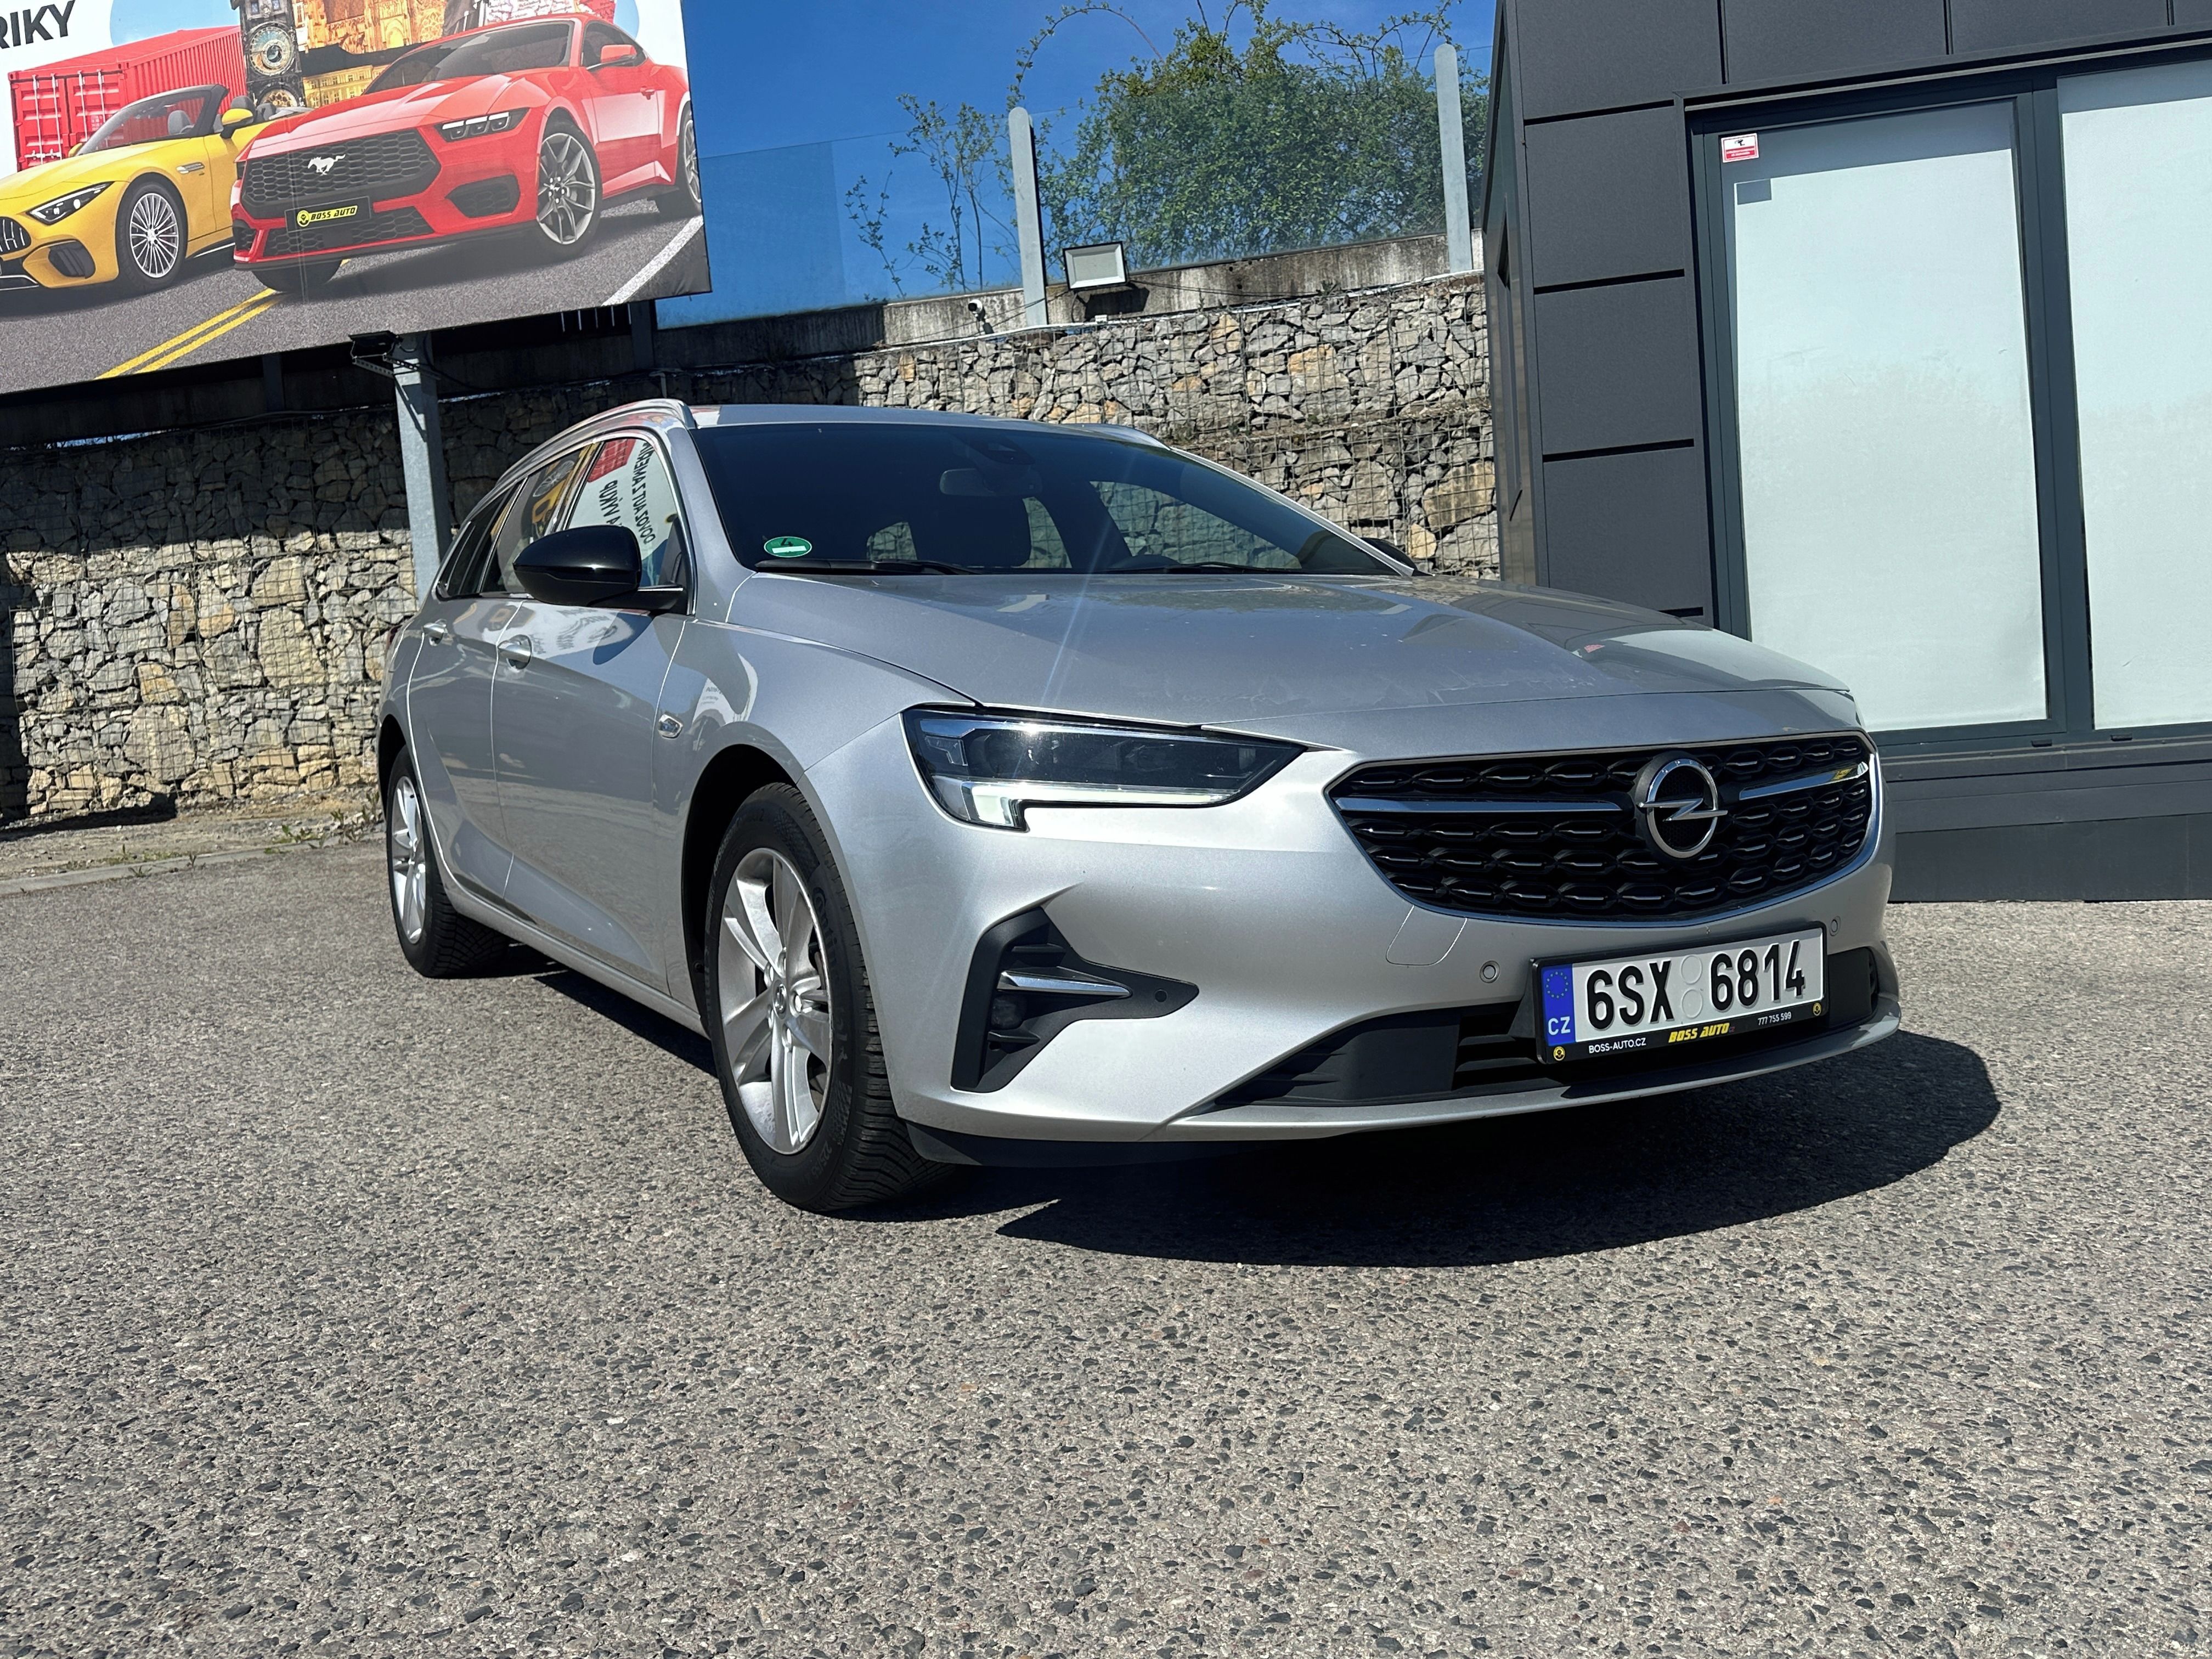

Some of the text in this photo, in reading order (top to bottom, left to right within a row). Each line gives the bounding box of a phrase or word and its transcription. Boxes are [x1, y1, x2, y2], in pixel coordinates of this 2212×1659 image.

[311, 207, 356, 220] BOSS AUTO
[1586, 939, 1805, 1030] 6SX 6814
[1548, 1016, 1571, 1035] CZ
[1758, 1012, 1792, 1025] 777 755 599
[1668, 1029, 1698, 1043] BOSS
[1700, 1023, 1730, 1038] AUTO
[1589, 1037, 1646, 1054] BOSS-AUTO.CZ
